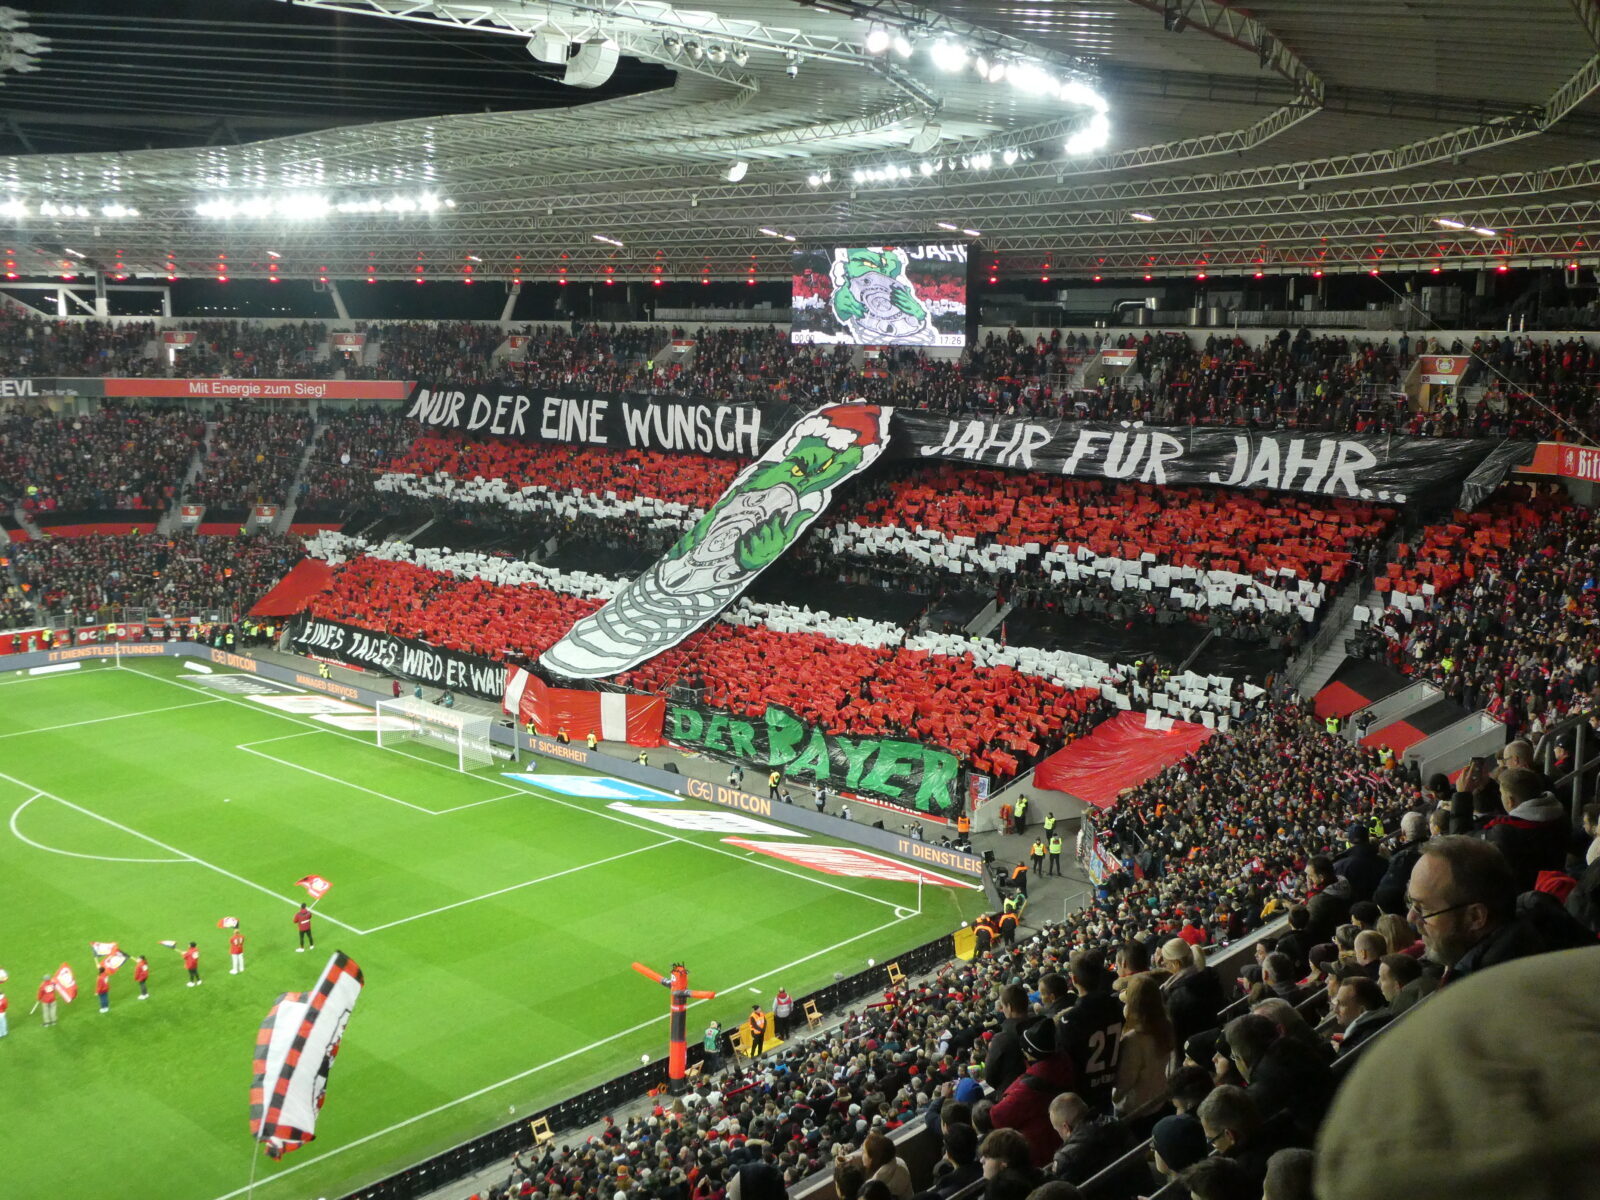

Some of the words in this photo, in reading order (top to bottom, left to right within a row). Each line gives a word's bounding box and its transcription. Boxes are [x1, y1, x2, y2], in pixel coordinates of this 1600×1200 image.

[940, 336, 962, 345] 17:26
[189, 382, 208, 394] Mit
[212, 382, 260, 397] Energie
[264, 385, 291, 395] zum
[295, 383, 326, 397] Sieg!
[406, 389, 465, 427] NUR
[466, 394, 530, 436] DER
[541, 397, 608, 443] EINE
[622, 402, 761, 456] WUNSCH
[920, 420, 1050, 469] JAHR
[1062, 420, 1184, 484] FÜR
[1208, 436, 1406, 503] JAHR...
[1577, 449, 1600, 479] Bit
[49, 652, 58, 661] IT
[227, 654, 257, 672] DITCON
[347, 632, 399, 668] TAGES
[403, 645, 443, 681] WIRD
[446, 660, 468, 688] ER
[296, 674, 326, 691] MANAGED
[328, 682, 359, 699] SERVICES
[529, 737, 537, 749] IT
[539, 741, 587, 763] SICHERHEIT
[671, 707, 758, 758] DER
[765, 706, 959, 811] BAYER
[718, 786, 771, 816] DITCON
[899, 838, 910, 853] IT
[912, 843, 982, 874] DIENSTLEIS
[1086, 1022, 1122, 1074] 27
